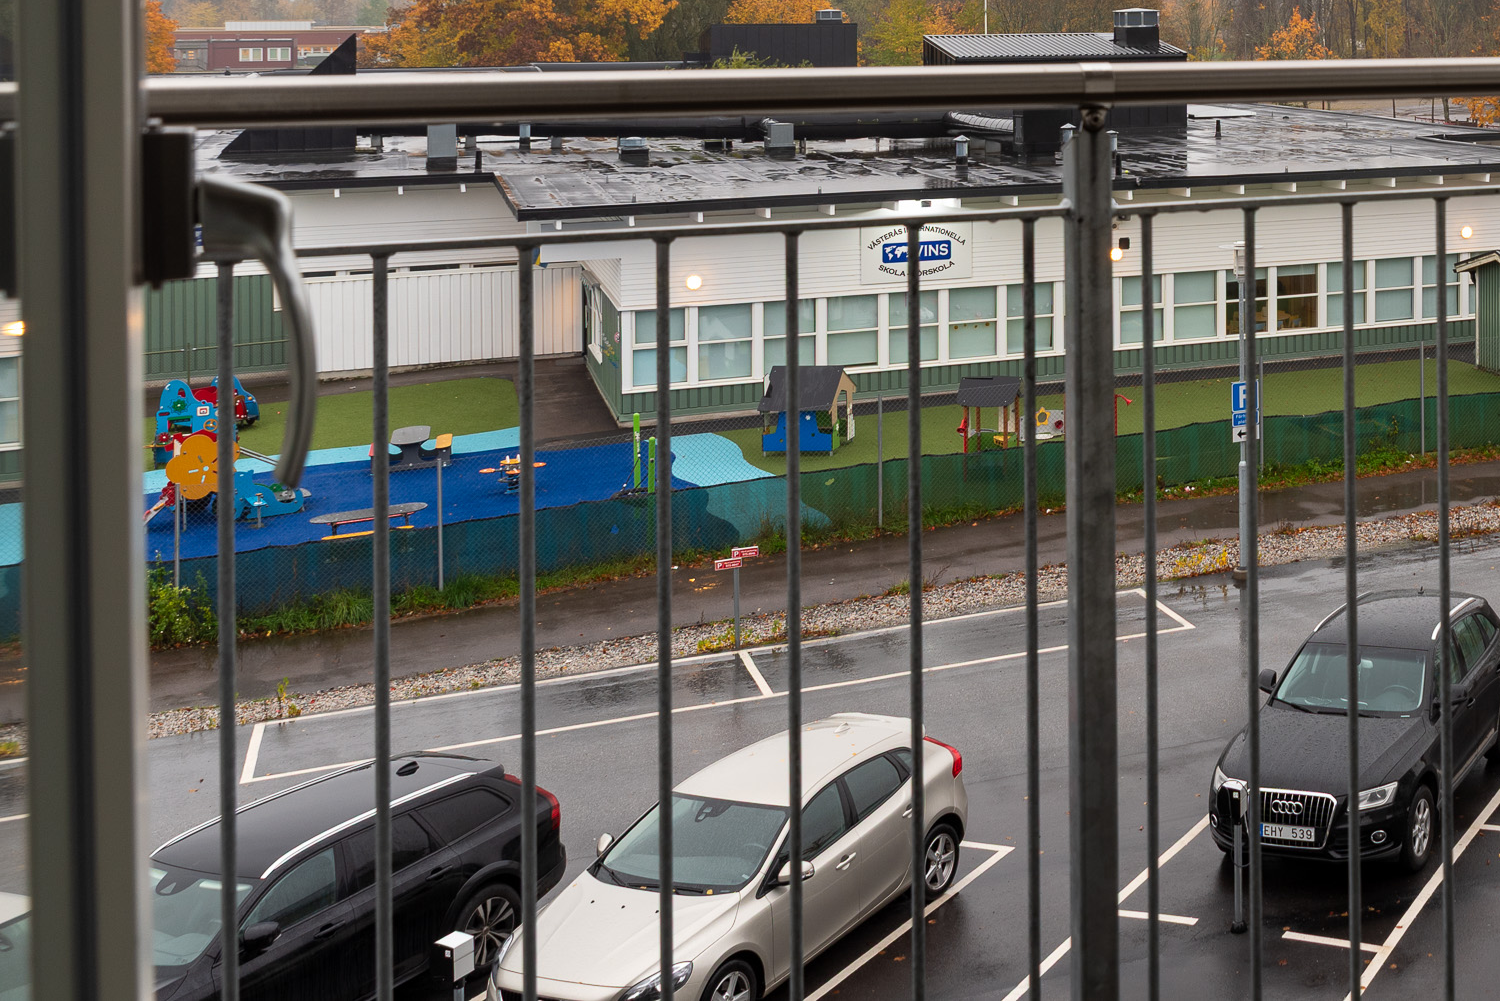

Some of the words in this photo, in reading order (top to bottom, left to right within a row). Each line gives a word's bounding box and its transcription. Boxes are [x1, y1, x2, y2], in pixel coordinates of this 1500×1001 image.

[867, 228, 902, 250] VÄSTERÅS
[904, 225, 966, 246] IRNATIONELLA
[878, 264, 906, 277] SKOLA
[1263, 825, 1283, 837] EHY
[1291, 828, 1312, 839] 539
